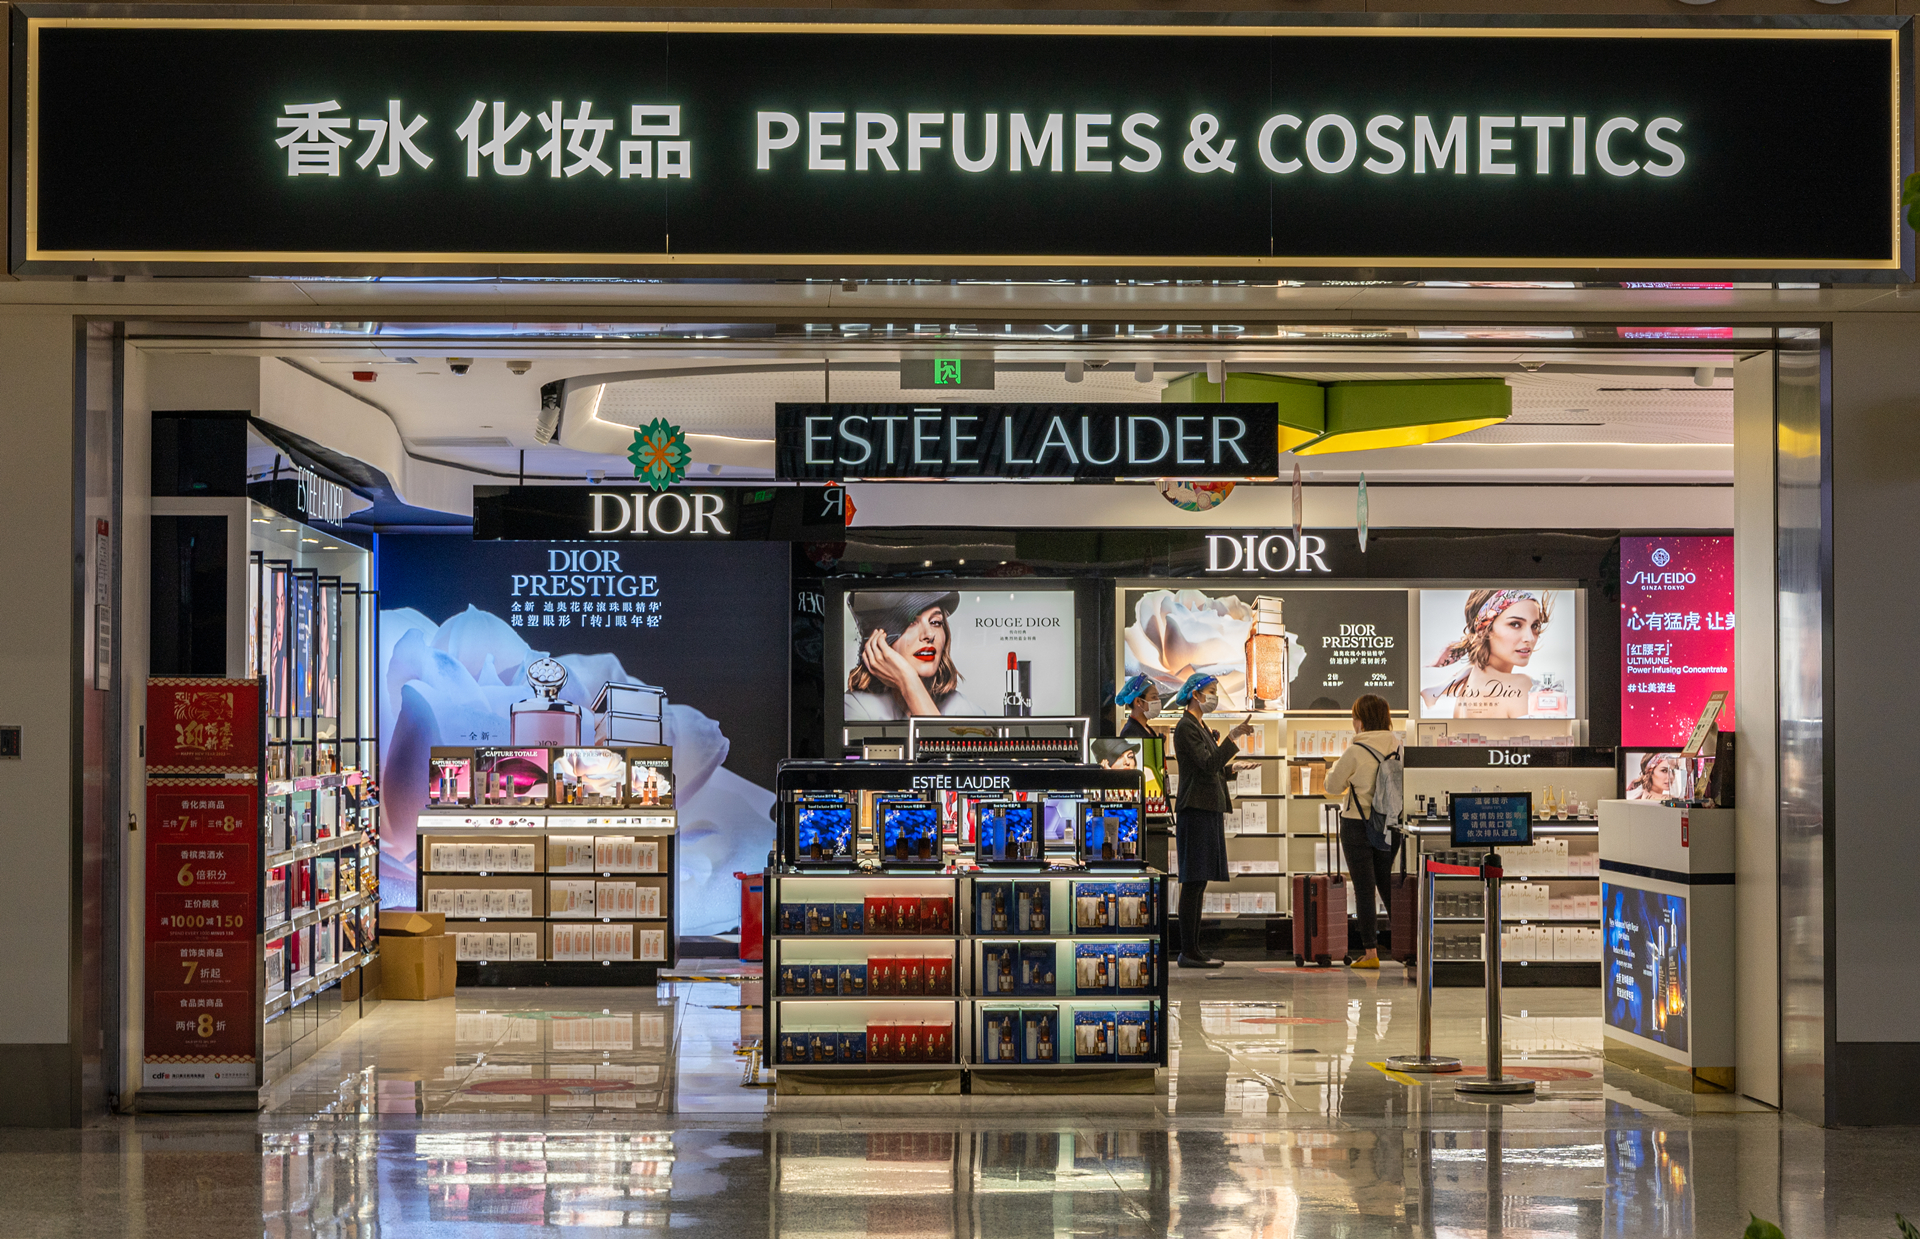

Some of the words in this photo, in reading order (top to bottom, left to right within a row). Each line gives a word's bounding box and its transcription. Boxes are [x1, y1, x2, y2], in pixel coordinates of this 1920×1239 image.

[274, 99, 434, 178] 香水
[456, 100, 692, 179] 化妆品
[756, 112, 1163, 174] PERFUMES
[1182, 113, 1237, 174] &
[1258, 113, 1686, 179] COSMETICS
[1004, 415, 1249, 464] LAUDER
[318, 476, 344, 529] LAUDER
[588, 492, 731, 535] DIOR
[547, 549, 623, 573] DIOR
[1204, 534, 1331, 572] DIOR
[511, 574, 660, 597] PRESTIGE
[1626, 571, 1696, 585] SHISEIDO
[975, 617, 1023, 628] ROUGE
[1026, 617, 1061, 628] DIOR
[1627, 611, 1701, 631] 心有猛虎
[1339, 623, 1377, 637] DIOR
[1322, 636, 1395, 648] PRESTIGE
[1627, 657, 1669, 665] ULTIMUNE
[1627, 665, 1651, 674] Power
[1652, 665, 1681, 675] Infusing
[1683, 665, 1728, 674] Concentrate
[1432, 679, 1480, 699] Miss
[1483, 679, 1523, 699] Dior
[1487, 750, 1531, 765] Dior
[955, 776, 1010, 789] LAUDER
[181, 800, 225, 809] 香化类商品
